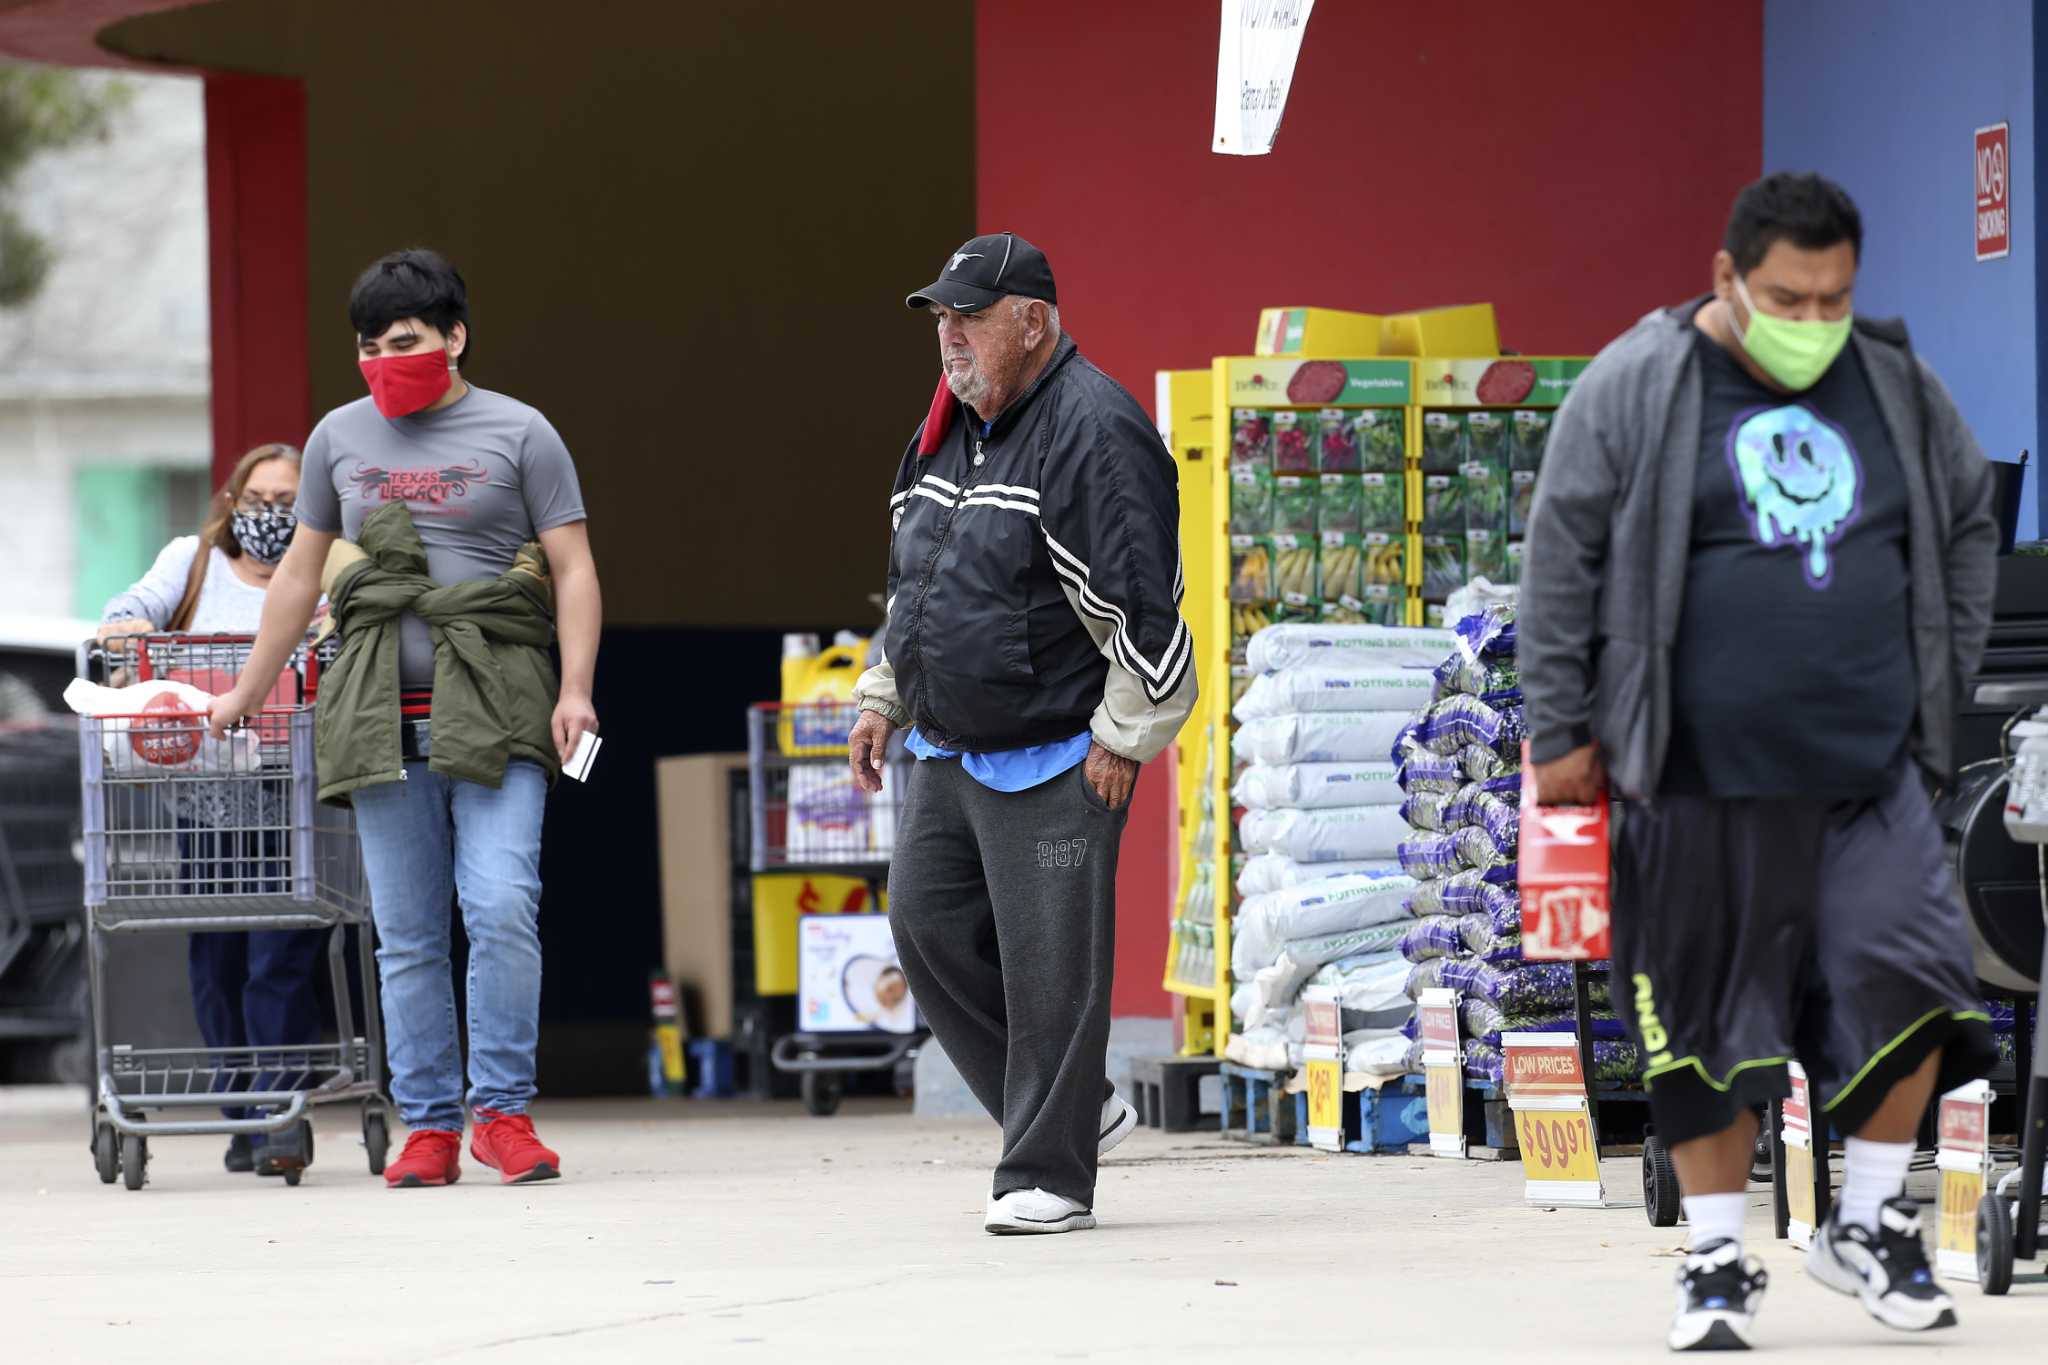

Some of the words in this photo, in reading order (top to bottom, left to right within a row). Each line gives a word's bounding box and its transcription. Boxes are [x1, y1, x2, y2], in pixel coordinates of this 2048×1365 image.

[390, 472, 440, 484] TEXAS
[379, 483, 450, 502] LEGACY
[1354, 679, 1403, 689] POTTING
[1407, 679, 1430, 689] SOIL
[1037, 838, 1087, 868] R87
[1511, 1055, 1536, 1074] LOW
[1537, 1055, 1576, 1074] PRICES
